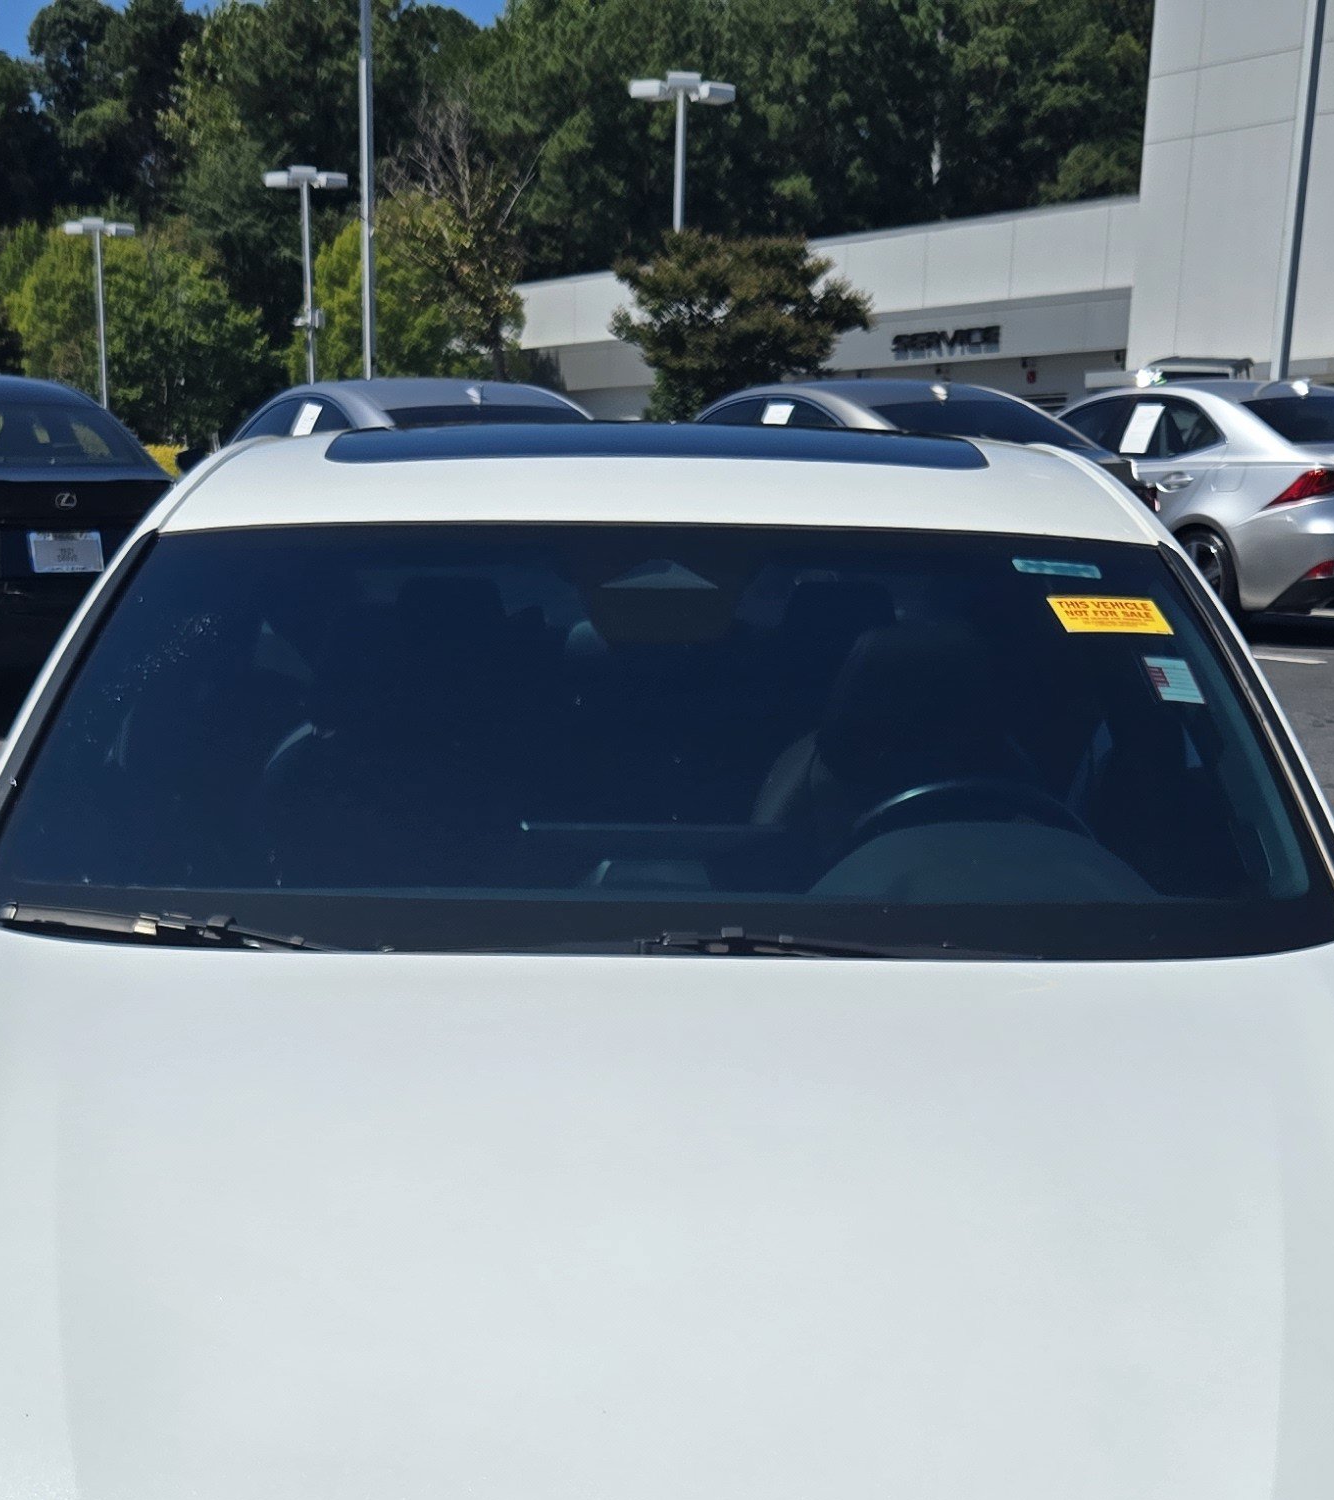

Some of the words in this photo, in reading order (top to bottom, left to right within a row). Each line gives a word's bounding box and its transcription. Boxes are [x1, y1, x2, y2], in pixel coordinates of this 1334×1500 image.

[891, 325, 1001, 352] SERVICE
[1057, 600, 1090, 609] THIS
[1092, 601, 1152, 611] VEHICLE
[1122, 611, 1153, 619] SALE
